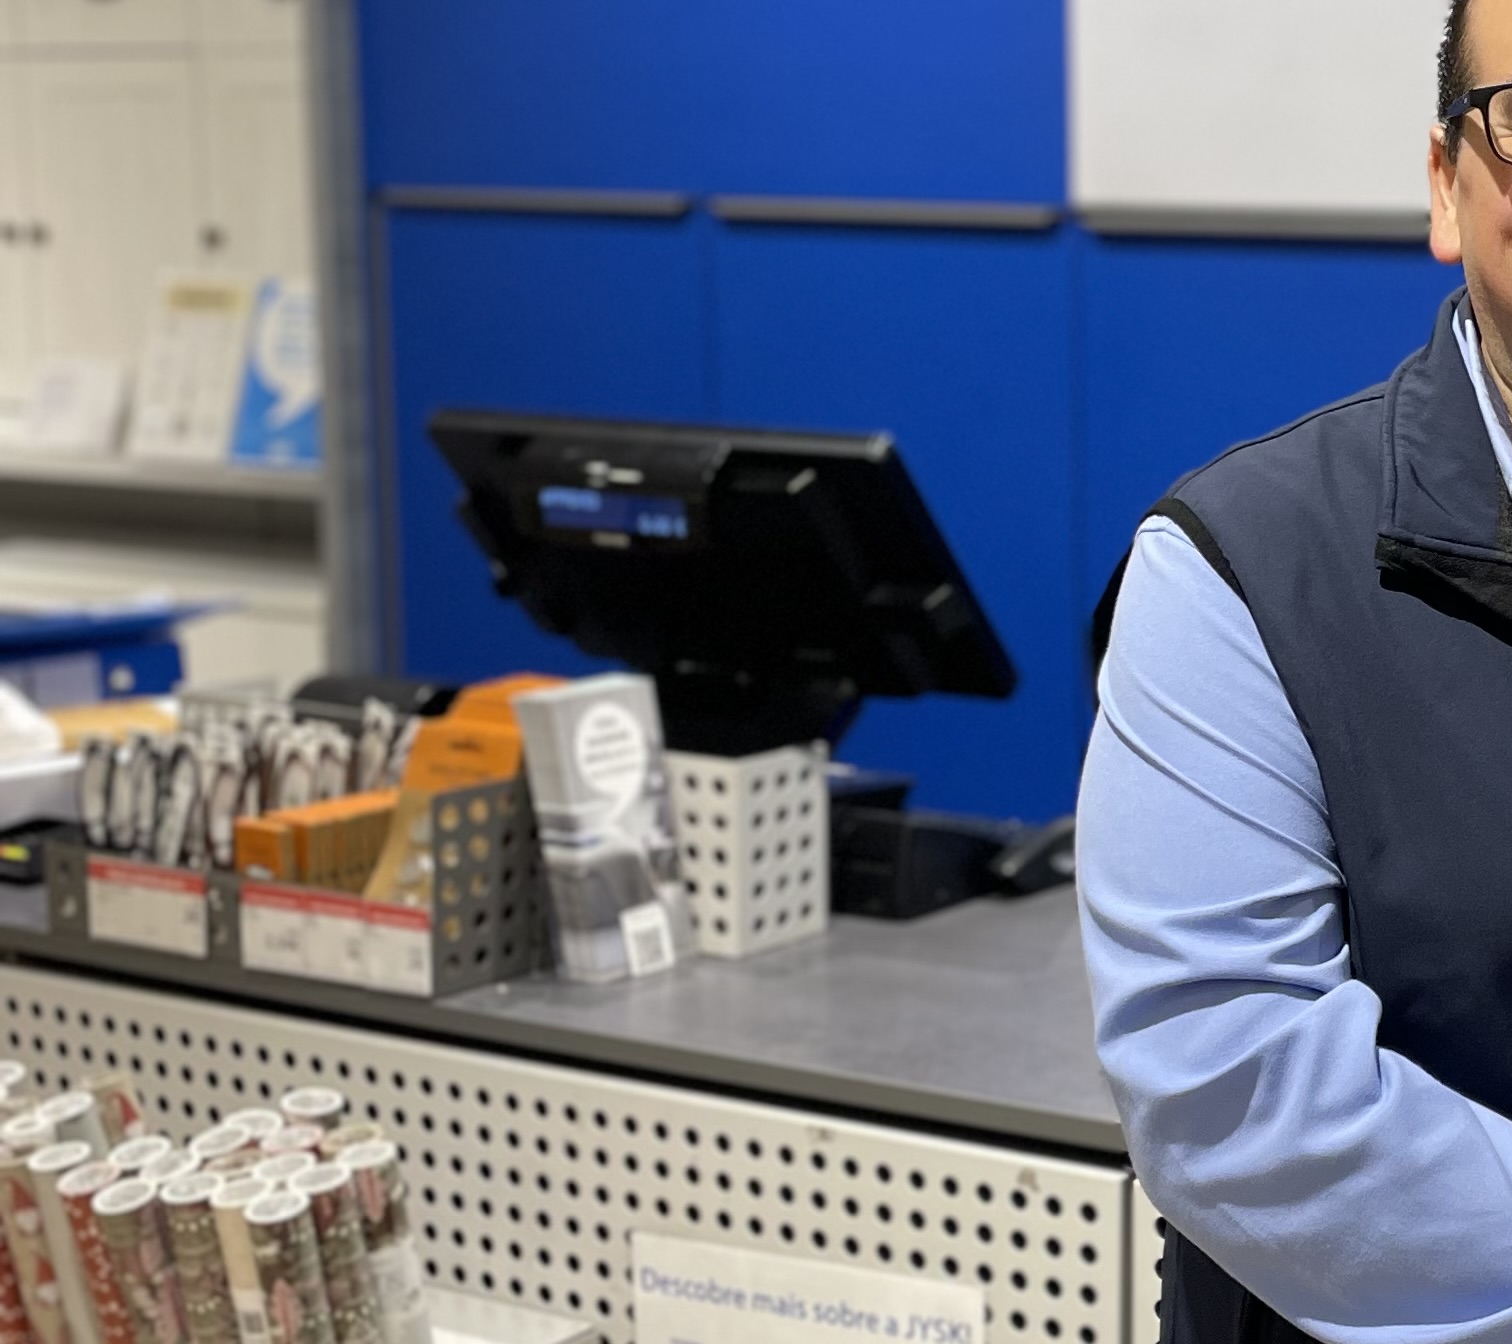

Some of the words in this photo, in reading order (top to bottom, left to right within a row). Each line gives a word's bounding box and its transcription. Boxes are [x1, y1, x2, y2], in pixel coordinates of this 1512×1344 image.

[640, 1267, 746, 1310] Descobre
[751, 1289, 808, 1319] mais
[814, 1299, 880, 1334] sobre
[884, 1318, 900, 1336] a
